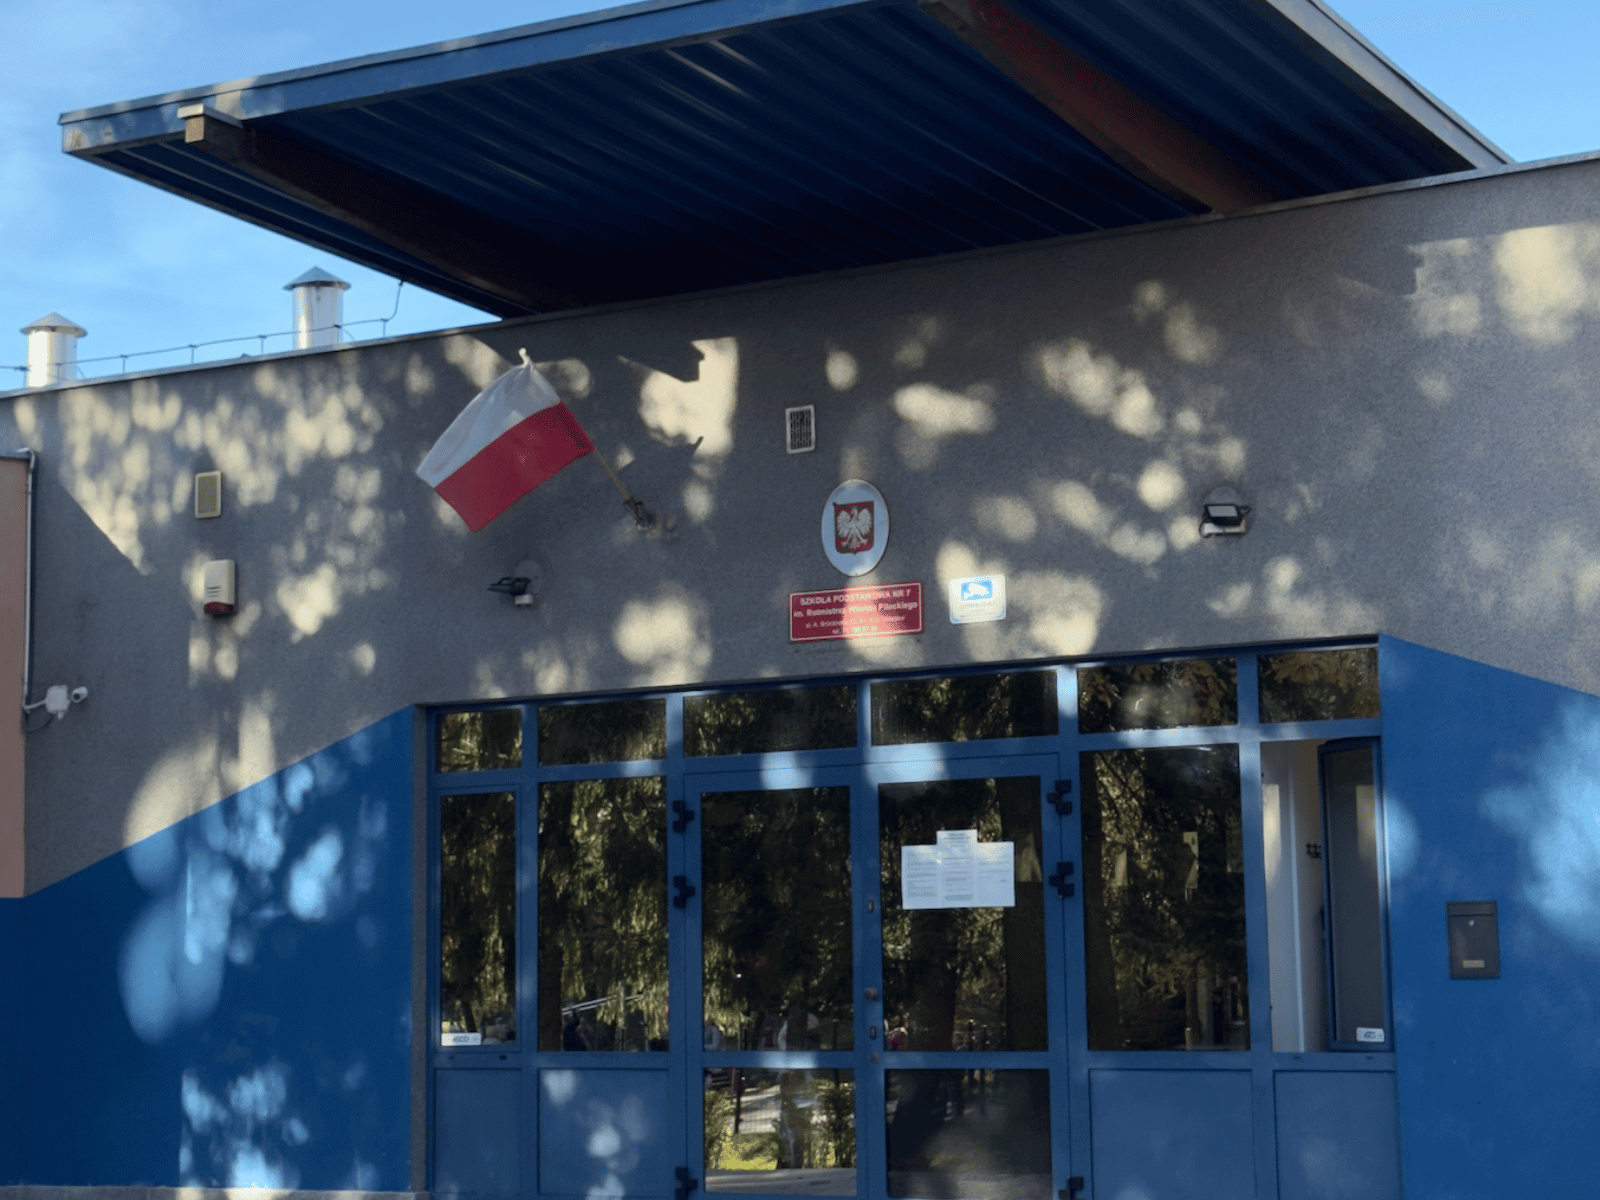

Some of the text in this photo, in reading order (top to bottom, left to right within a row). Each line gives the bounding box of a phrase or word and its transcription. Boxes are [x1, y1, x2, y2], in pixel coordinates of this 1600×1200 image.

[833, 591, 891, 603] PODSTAWOWA
[892, 589, 905, 598] NR
[906, 588, 911, 597] 7
